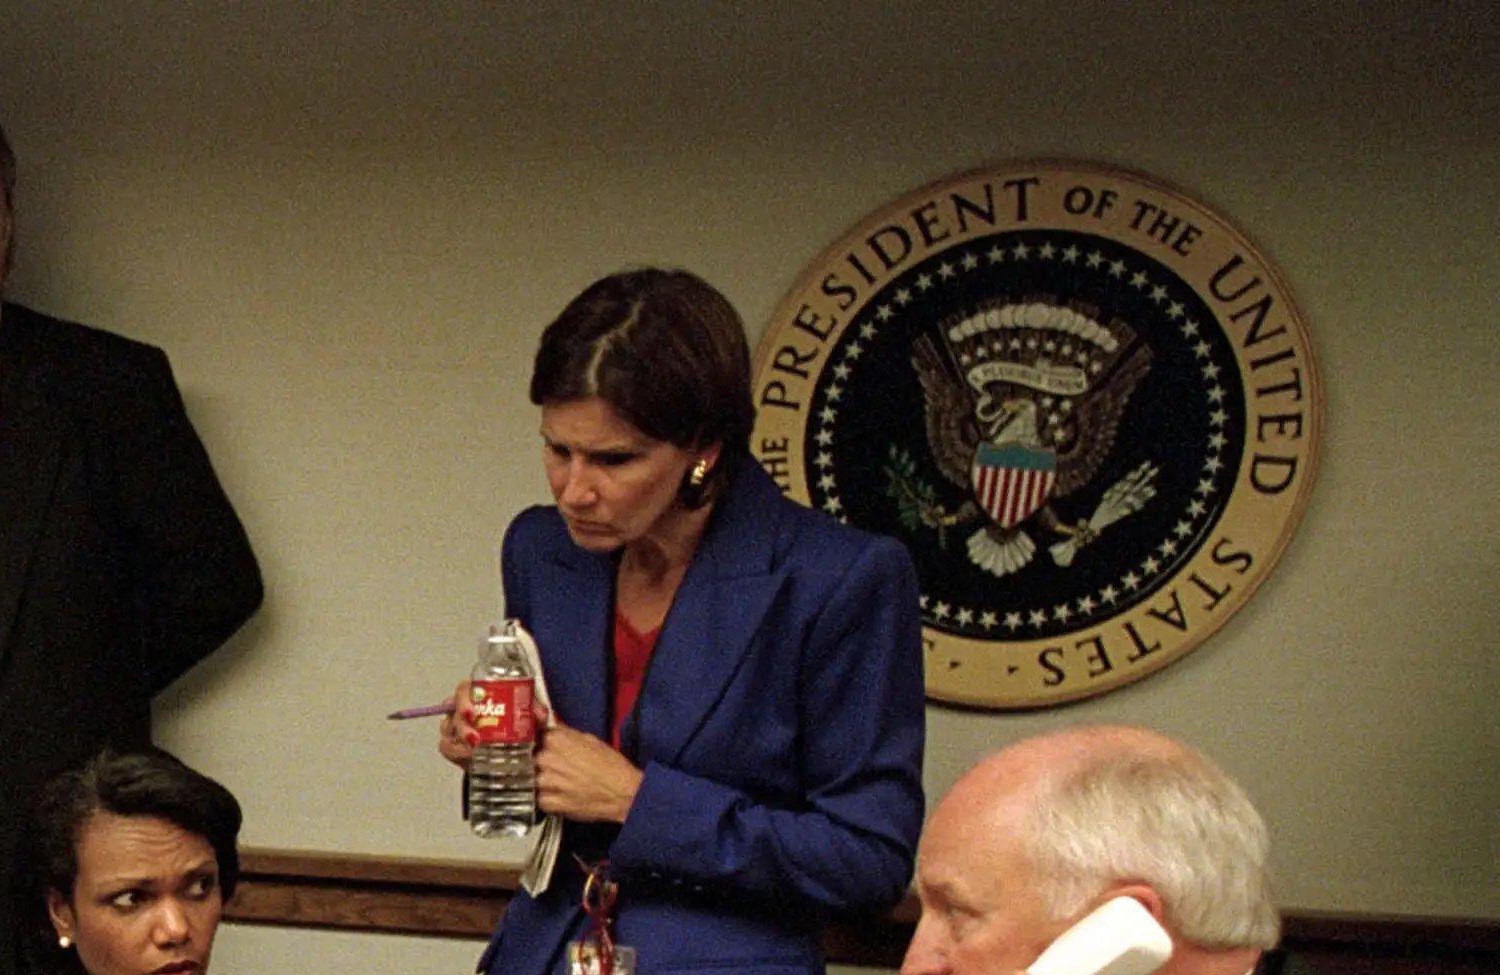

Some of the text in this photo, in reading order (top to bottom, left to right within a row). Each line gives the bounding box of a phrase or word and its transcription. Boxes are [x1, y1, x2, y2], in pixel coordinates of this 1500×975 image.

[1063, 184, 1118, 217] OF
[1131, 200, 1203, 257] THE
[762, 177, 1039, 412] PRESIDENT
[1208, 255, 1303, 496] UNITED
[1038, 536, 1254, 687] STATES
